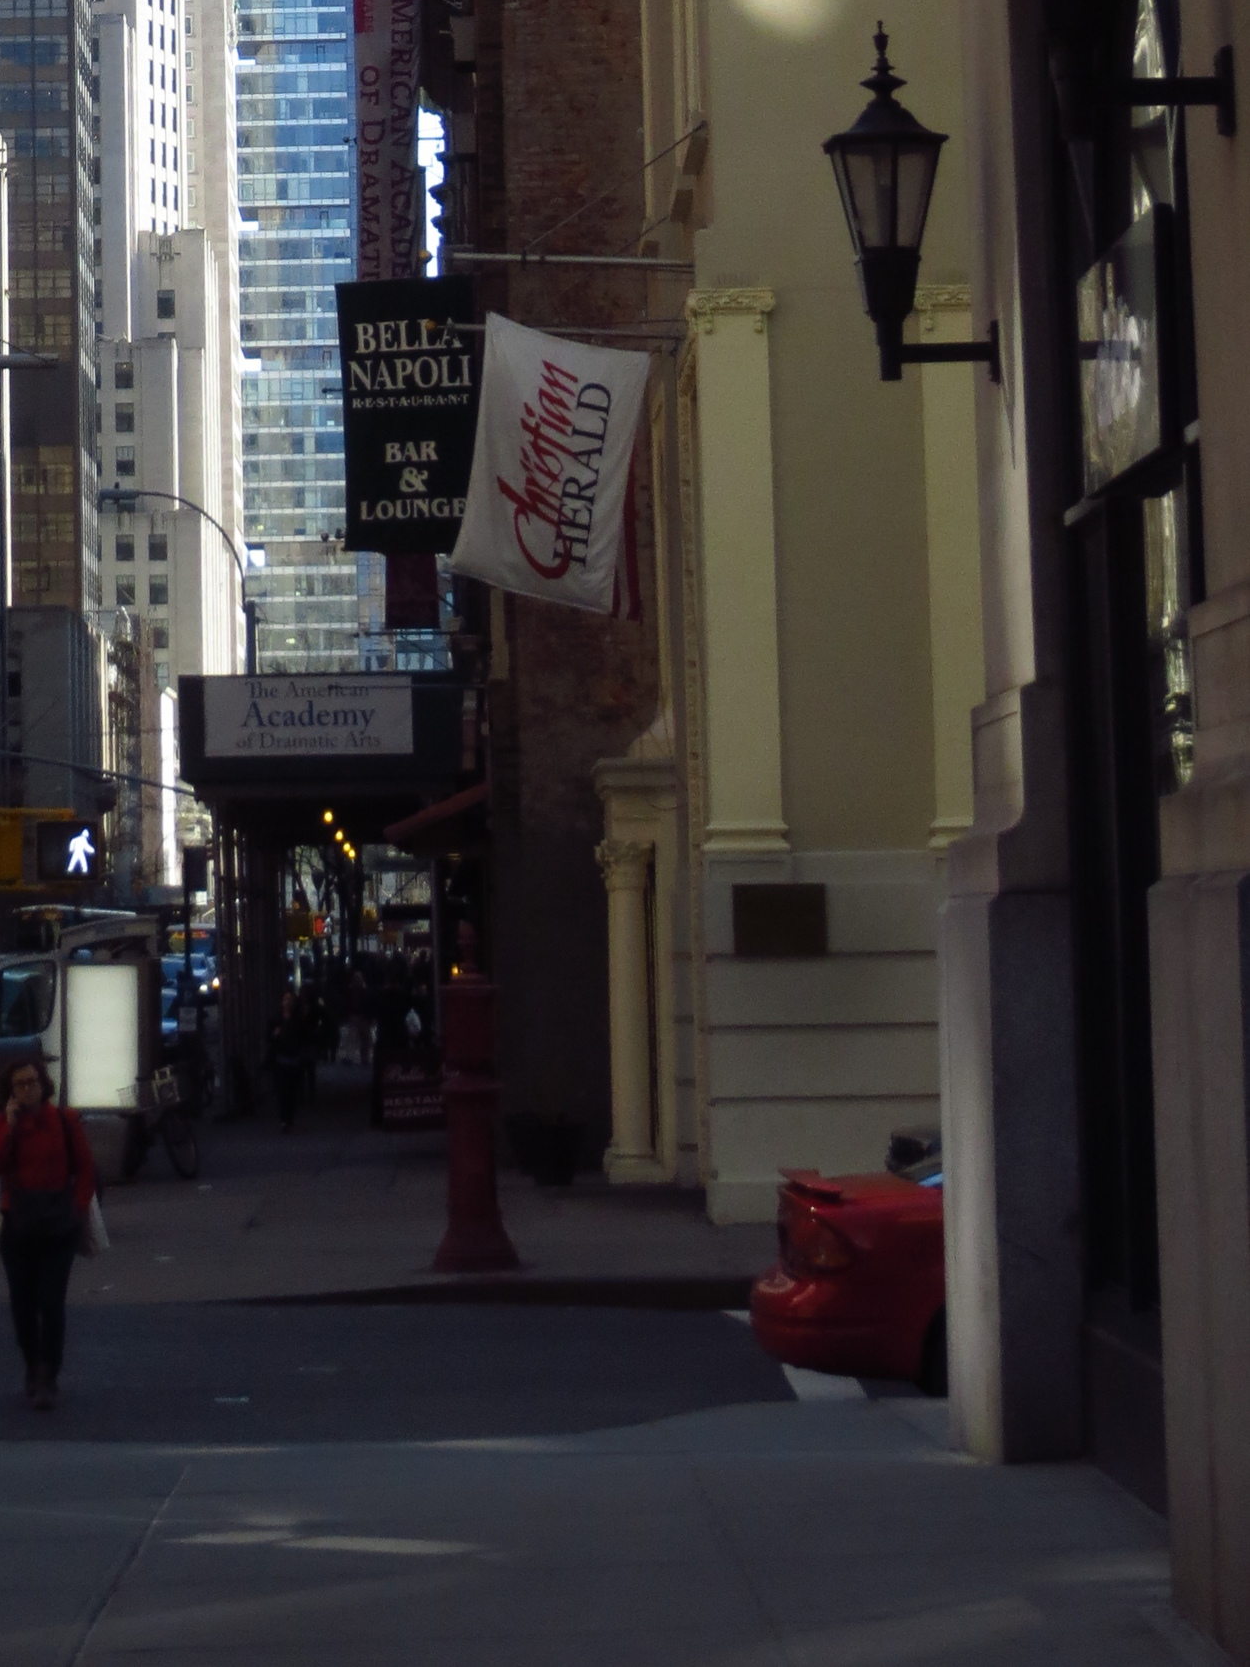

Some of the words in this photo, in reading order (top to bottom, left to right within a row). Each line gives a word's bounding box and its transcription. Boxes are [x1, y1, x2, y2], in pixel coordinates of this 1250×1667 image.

[359, 65, 380, 107] OF
[360, 119, 386, 280] DRAMATI
[390, 160, 416, 279] ACADE
[354, 316, 464, 355] BELLA
[347, 354, 473, 392] NAPOLI
[383, 440, 439, 463] BAR
[496, 359, 579, 580] Christian
[399, 466, 428, 493] &
[552, 382, 612, 568] HERALD
[359, 497, 467, 522] LOUNGE
[245, 681, 279, 699] The
[285, 680, 371, 699] American
[241, 699, 376, 733] Academy
[236, 731, 256, 749] of
[259, 731, 337, 749] Dramatic
[343, 731, 381, 749] Arts
[383, 1094, 445, 1107] RESTAU
